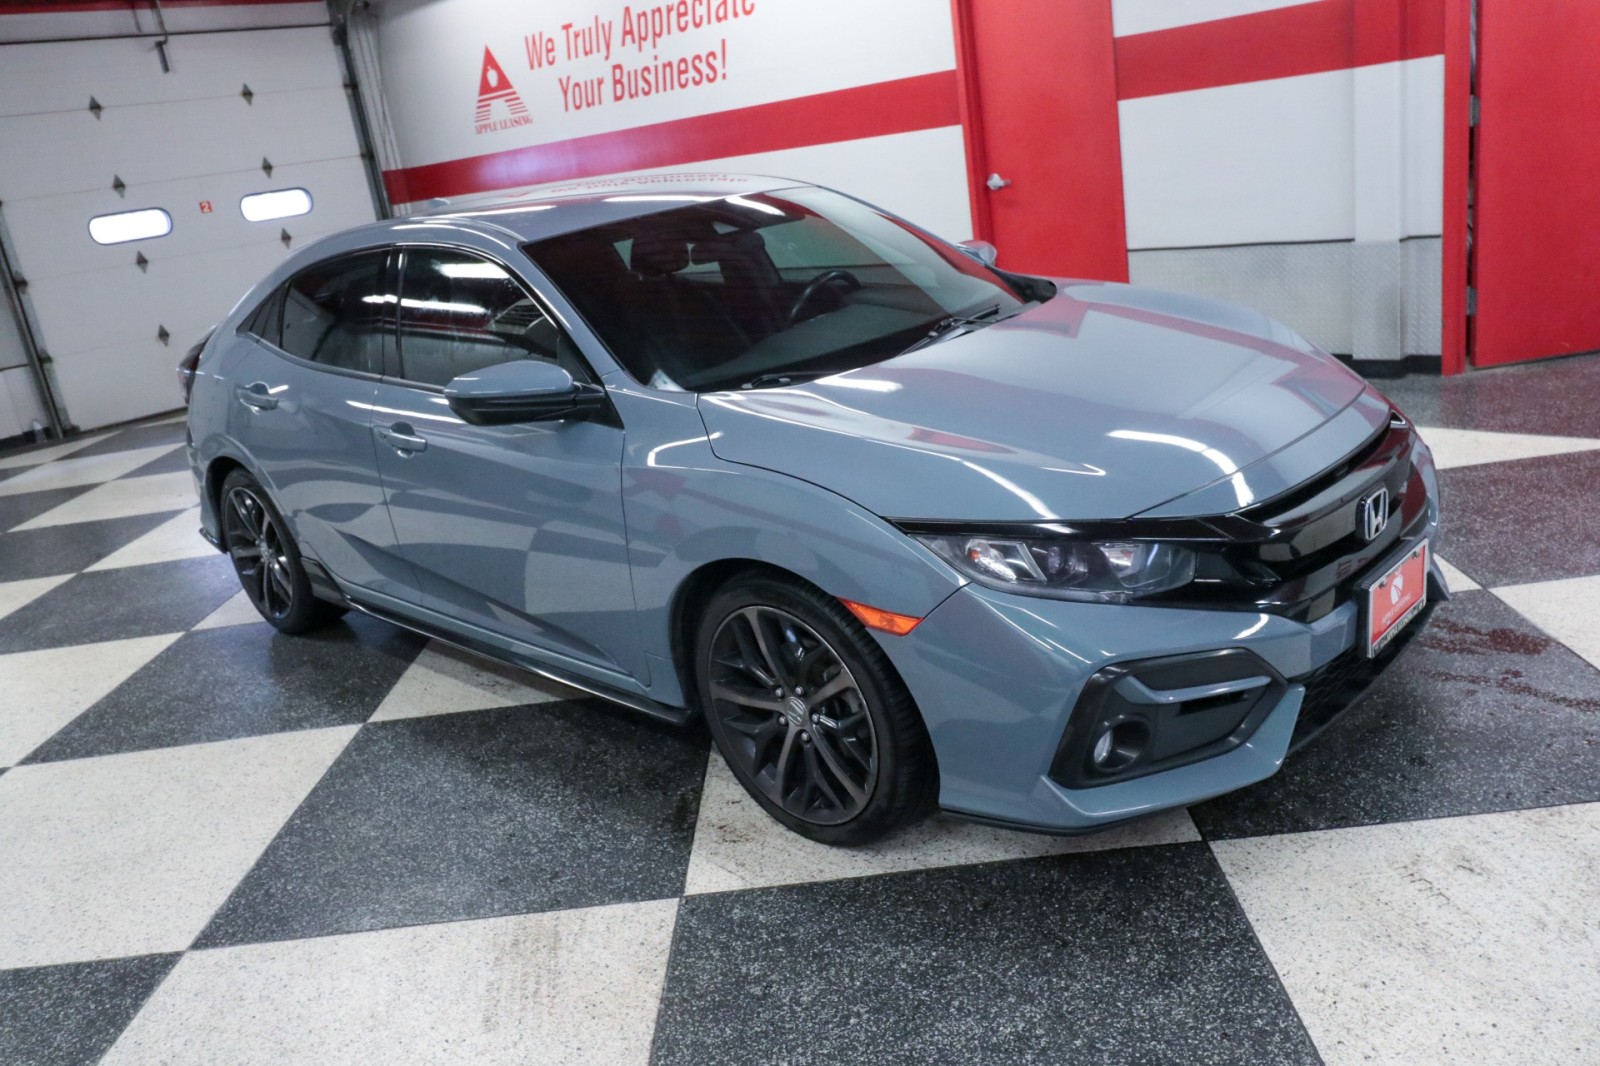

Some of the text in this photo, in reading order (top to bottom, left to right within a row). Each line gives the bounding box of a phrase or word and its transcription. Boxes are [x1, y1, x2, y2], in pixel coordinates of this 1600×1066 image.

[525, 31, 555, 70] We
[561, 15, 612, 61] Truly
[558, 38, 727, 112] Your Business!
[475, 115, 533, 135] APPLE LEASING
